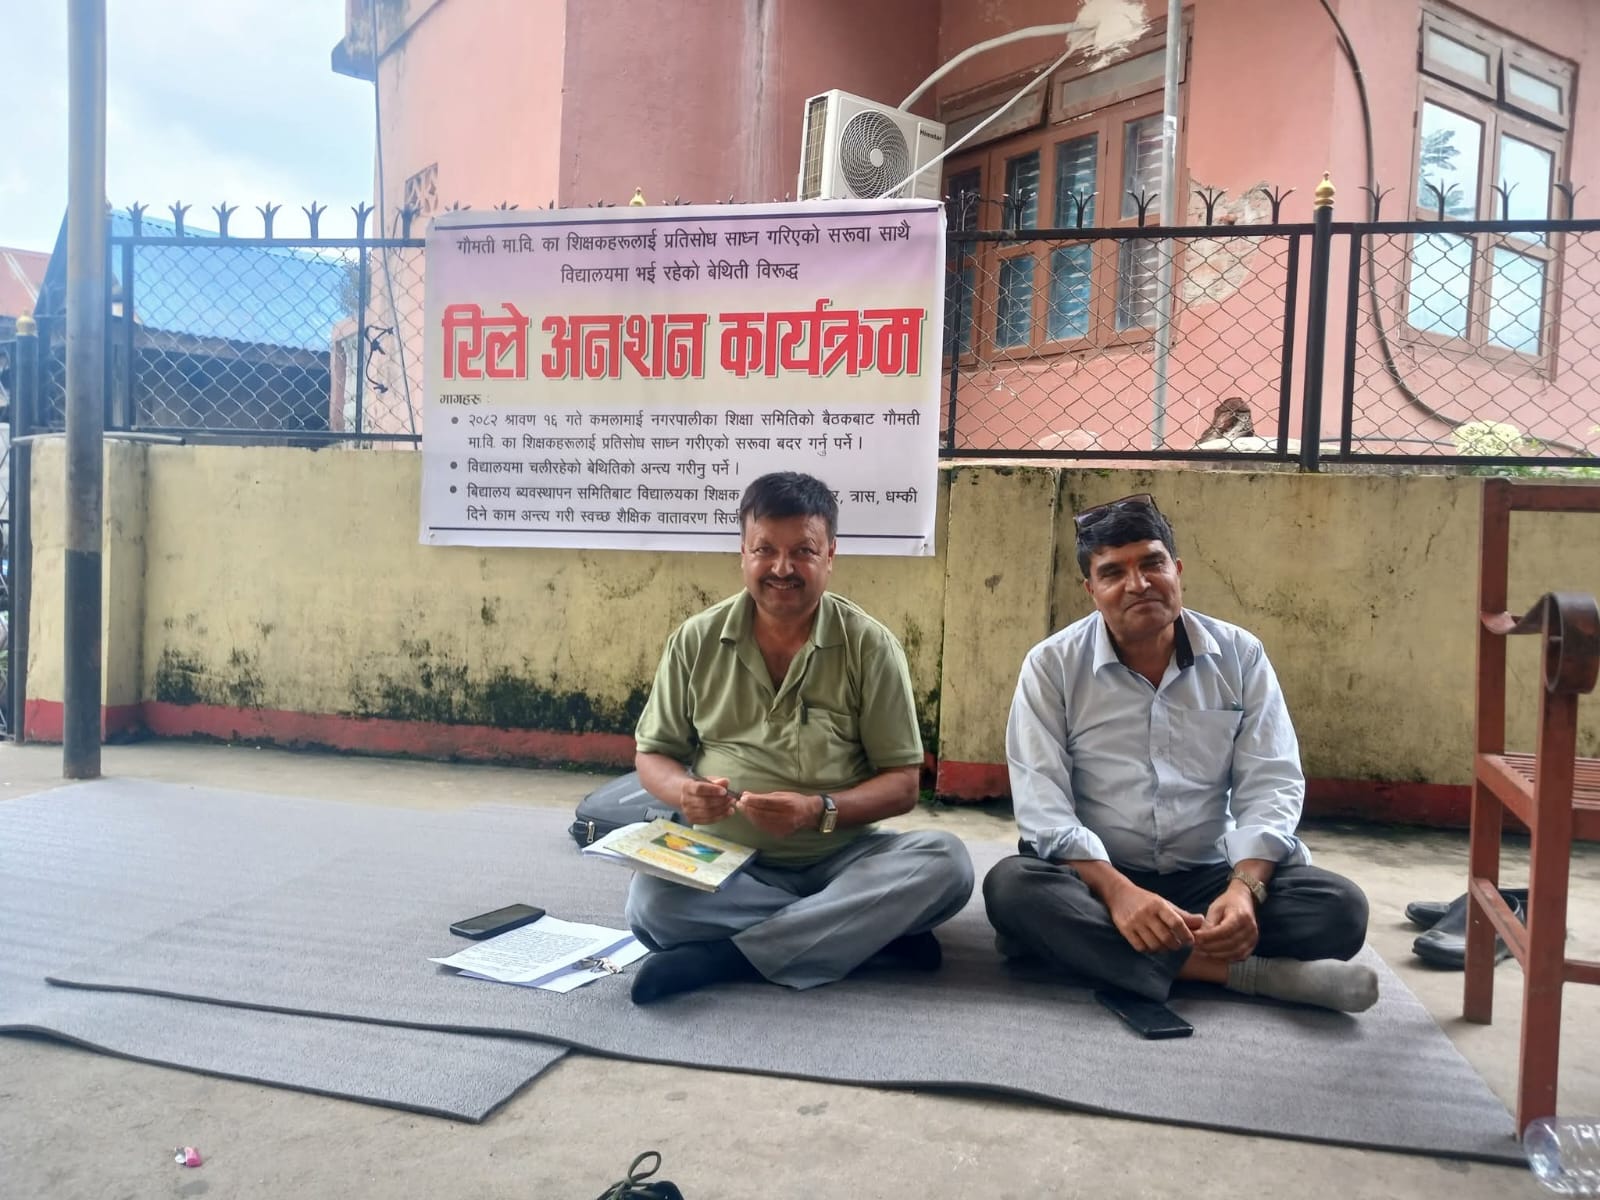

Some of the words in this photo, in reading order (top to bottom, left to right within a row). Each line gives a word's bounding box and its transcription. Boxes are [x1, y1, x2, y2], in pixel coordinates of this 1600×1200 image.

[456, 235, 495, 255] गौमती
[542, 236, 559, 252] का
[567, 229, 657, 252] शिक्षकहरूलाई
[664, 227, 718, 249] प्रतिसोध
[767, 223, 820, 246] गरिएको
[828, 225, 871, 244] सरूवा
[879, 219, 912, 242] साथै
[560, 264, 629, 284] विद्यालयमा
[635, 260, 656, 284] भई
[663, 260, 700, 282] रहेको
[707, 259, 750, 281] बेथिती
[756, 258, 801, 281] विरूद्ध
[441, 302, 531, 381] रिले
[541, 313, 709, 381] अनशन
[718, 298, 928, 379] कार्यक्रम
[468, 415, 498, 426] २०८२
[504, 413, 536, 426] श्रावण
[544, 415, 558, 427] १६
[565, 410, 582, 426] गते
[589, 410, 644, 428] कमलामाई
[650, 411, 718, 427] नगरपालीका
[724, 410, 754, 426] शिक्षा
[761, 409, 815, 427] समितिको
[821, 409, 876, 426] बैठकबाट
[882, 409, 921, 427] गौमती
[501, 437, 516, 449] का
[522, 434, 596, 450] शिक्षकहरूलाई
[602, 434, 645, 450] प्रतिसोध
[685, 433, 729, 451] गरीएको
[735, 437, 771, 451] सरूवा
[776, 437, 802, 451] बदर
[808, 433, 828, 456] गर्नु
[833, 433, 853, 450] पर्ने
[467, 457, 523, 475] विद्यालयमा
[528, 458, 581, 475] चलीरहेको
[587, 458, 635, 475] बेथितिको
[641, 462, 671, 475] अन्त्य
[676, 459, 706, 479] गरीनु
[712, 458, 731, 476] पर्ने
[577, 484, 632, 500] समितिबाट
[637, 485, 699, 501] विद्यालयका
[704, 484, 741, 501] शिक्षक
[849, 490, 880, 505] त्रास,
[886, 486, 918, 503] धम्की
[466, 505, 487, 521] दिने
[492, 509, 516, 521] काम
[521, 509, 550, 522] अन्त्य
[555, 507, 575, 521] गरी
[580, 510, 612, 523] स्वच्छ
[616, 507, 652, 523] शैक्षिक
[657, 510, 708, 525] वातावरण
